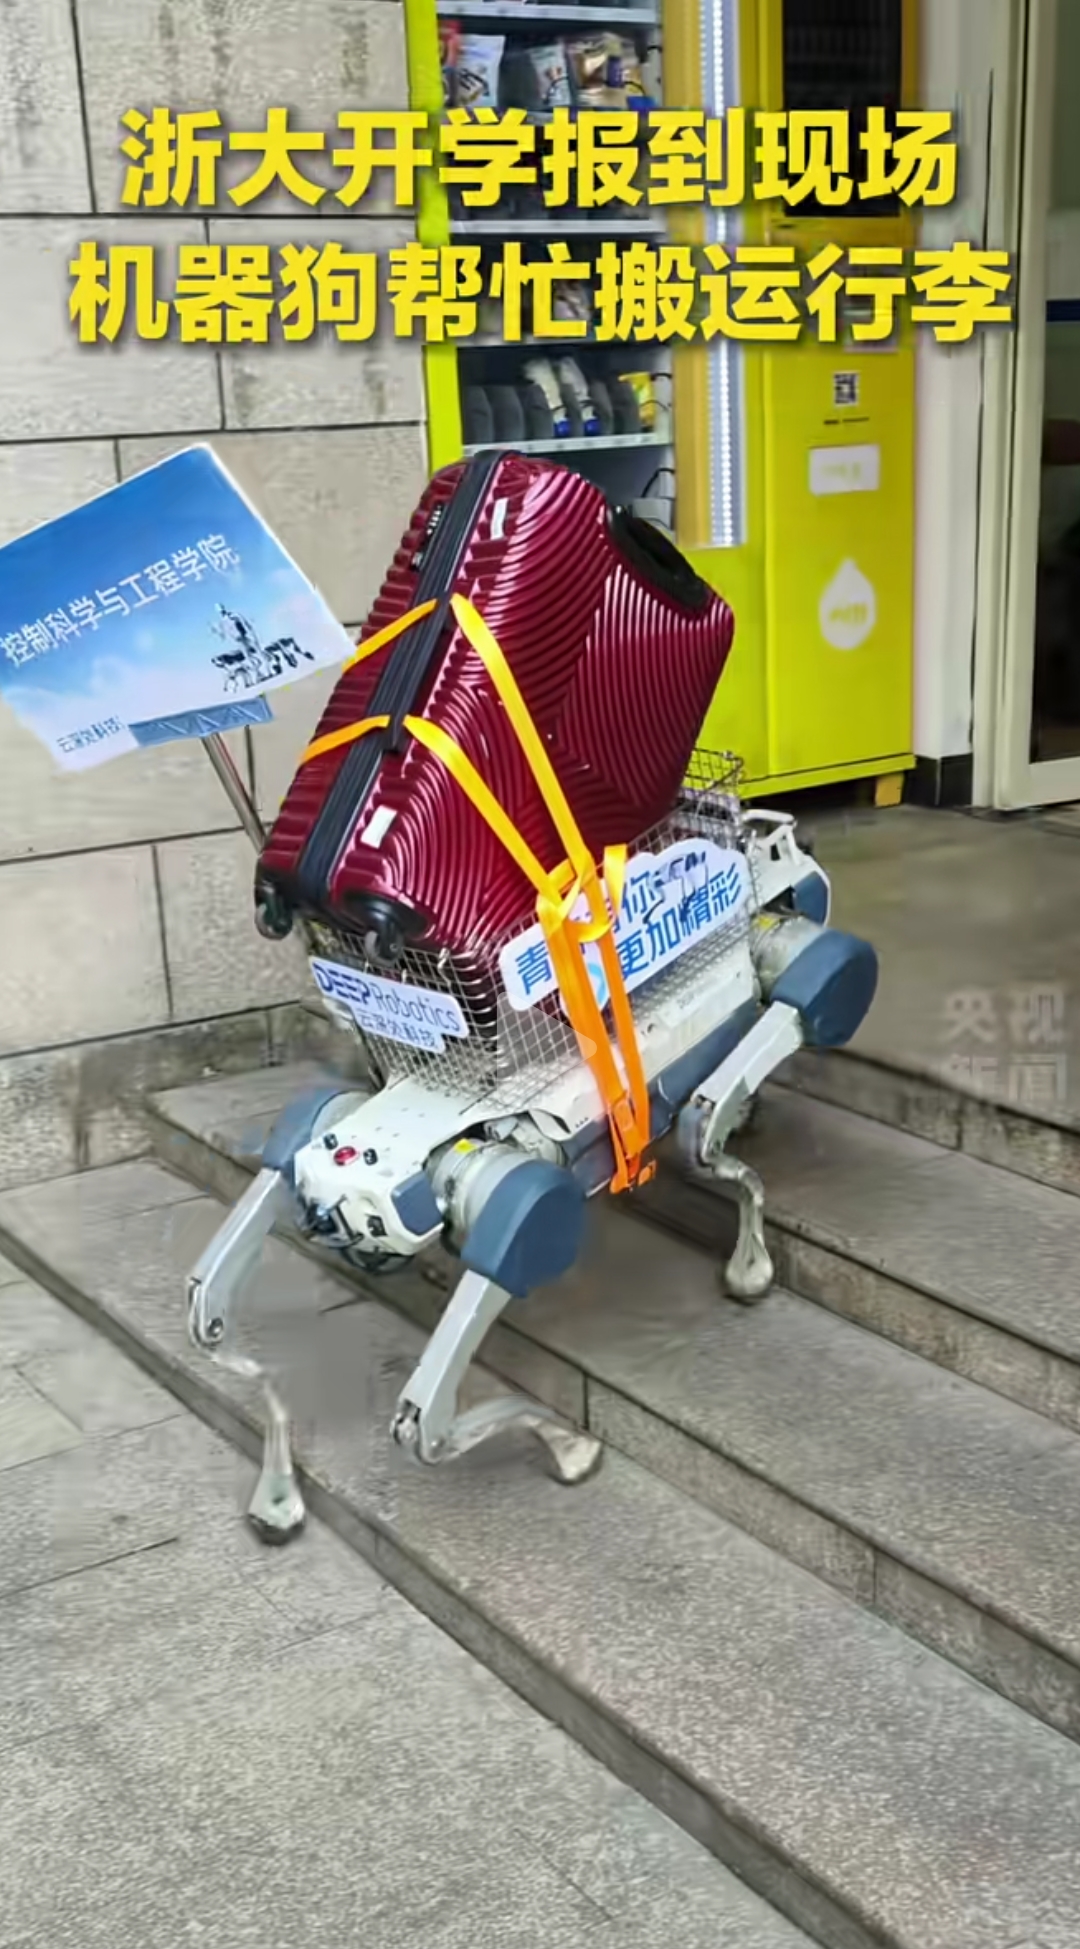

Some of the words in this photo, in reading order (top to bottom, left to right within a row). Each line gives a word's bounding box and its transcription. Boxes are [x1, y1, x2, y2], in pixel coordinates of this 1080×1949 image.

[0, 533, 241, 668] 控制科学与工程学院
[514, 870, 657, 996] 青你
[616, 862, 742, 982] 更加精彩
